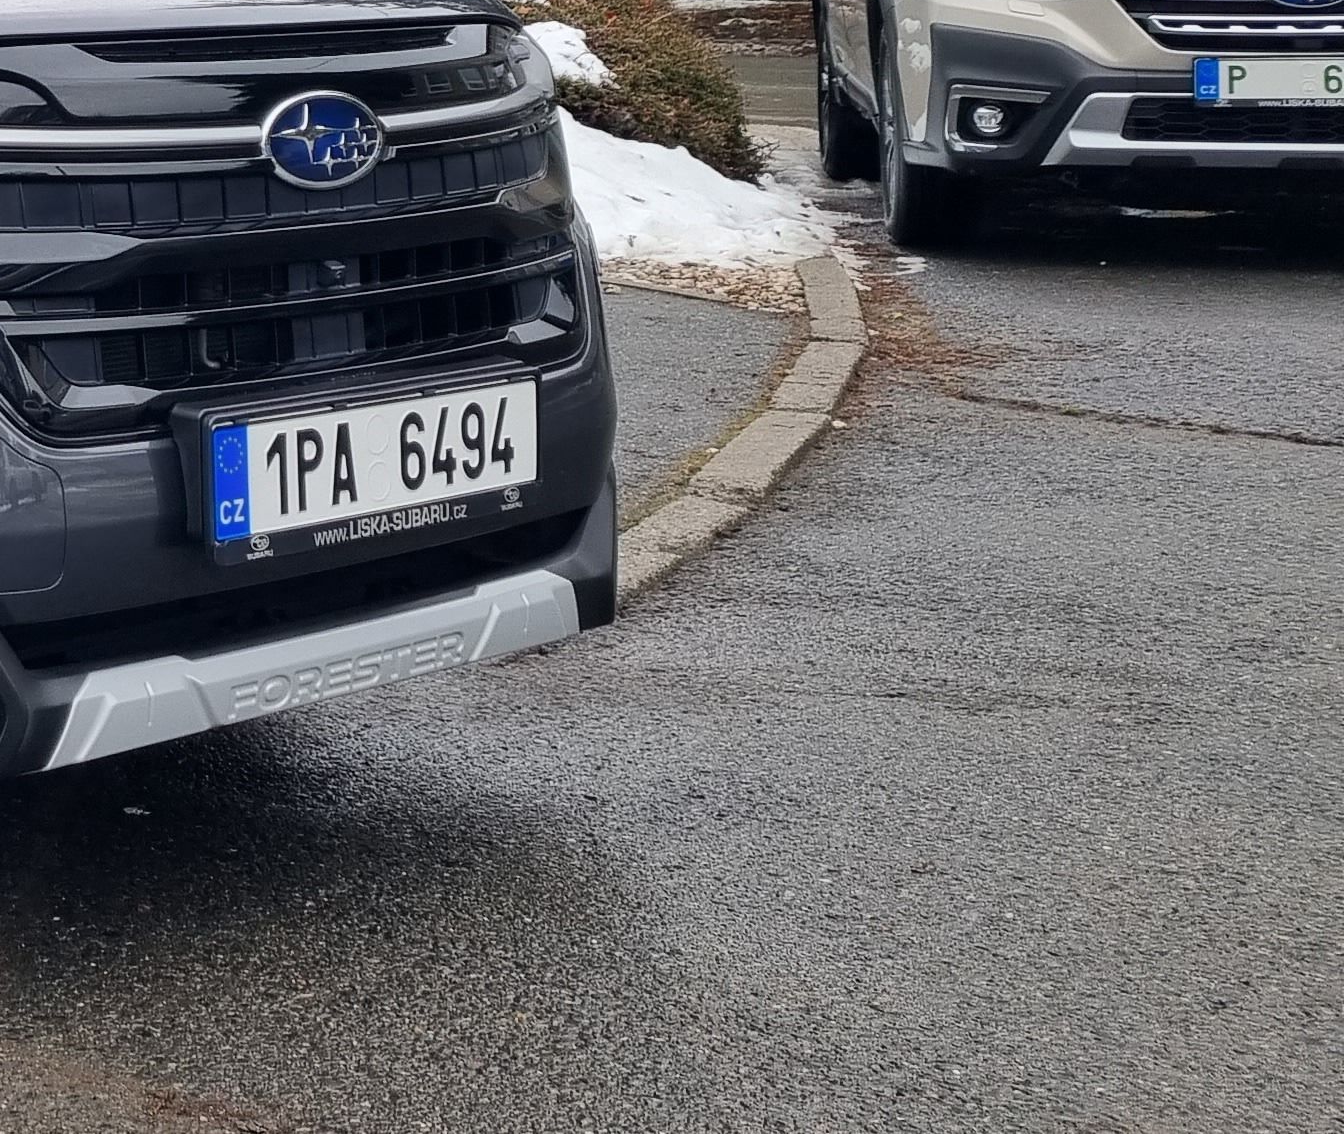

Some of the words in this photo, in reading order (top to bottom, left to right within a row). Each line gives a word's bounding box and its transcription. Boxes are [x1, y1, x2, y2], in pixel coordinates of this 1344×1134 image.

[1199, 85, 1217, 94] CZ
[1228, 65, 1247, 94] P
[265, 421, 359, 516] 1PA
[399, 396, 515, 493] 6494
[219, 497, 245, 526] CZ
[313, 502, 468, 547] www.LISKA-SUBARU.cz
[227, 630, 466, 721] FORESTER
